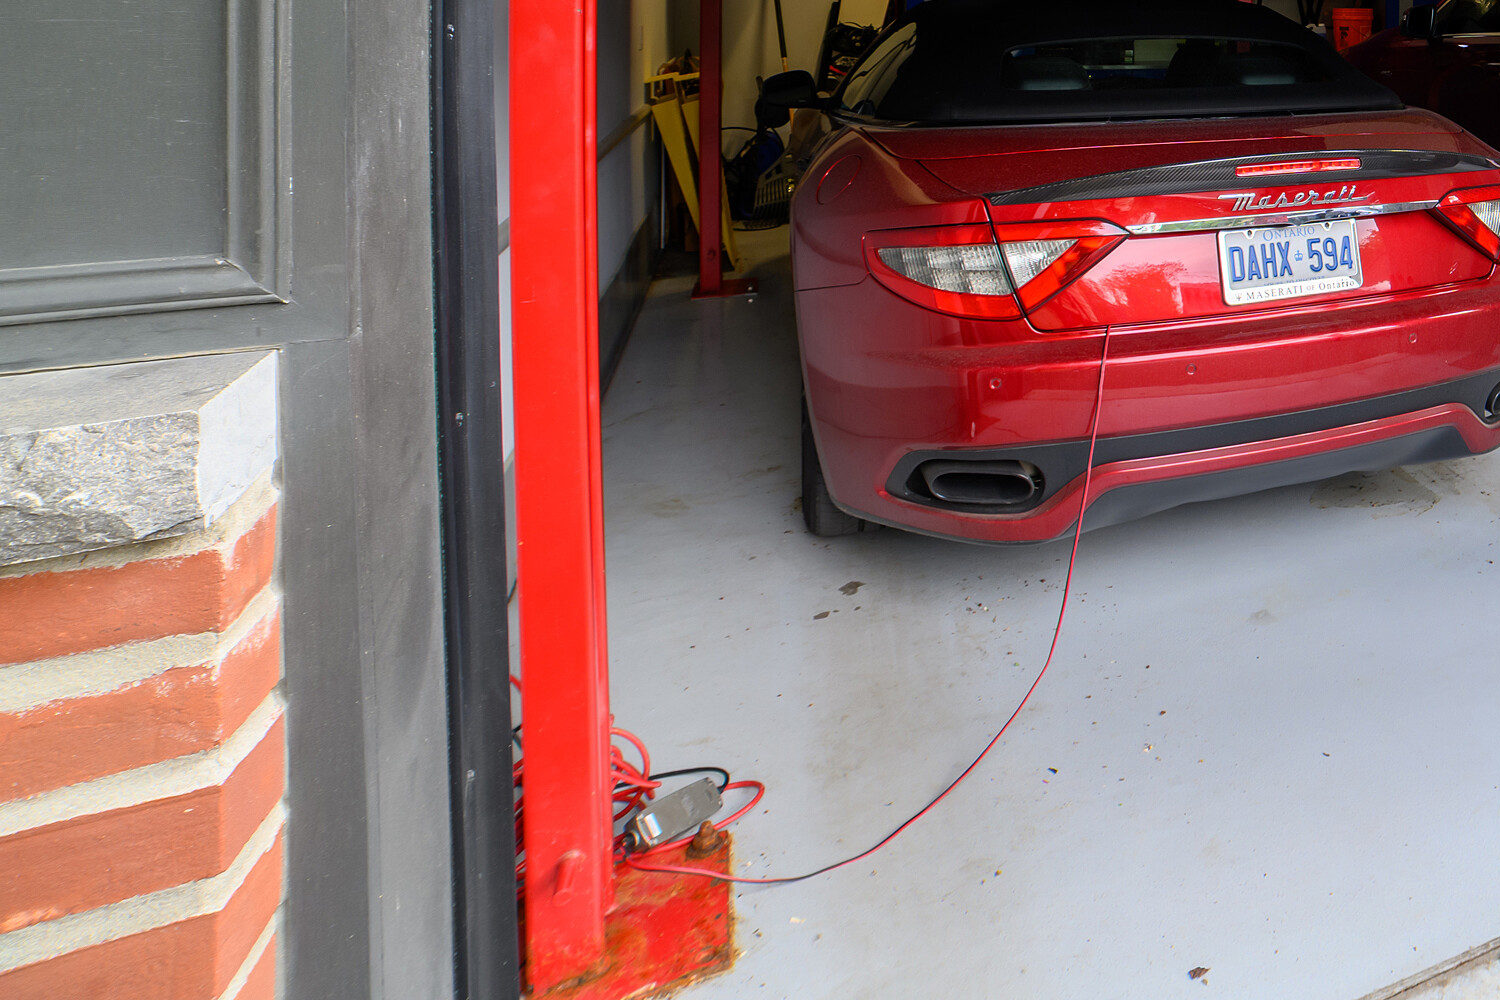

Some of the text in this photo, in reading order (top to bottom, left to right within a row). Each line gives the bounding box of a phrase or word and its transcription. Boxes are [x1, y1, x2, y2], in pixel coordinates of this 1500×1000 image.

[1217, 185, 1376, 212] Maserati
[1262, 226, 1315, 242] ONTARIO
[1228, 235, 1354, 283] DAHX 594
[1246, 285, 1303, 301] MASERATI
[1306, 283, 1316, 291] OF
[1318, 278, 1355, 291] Ontario
